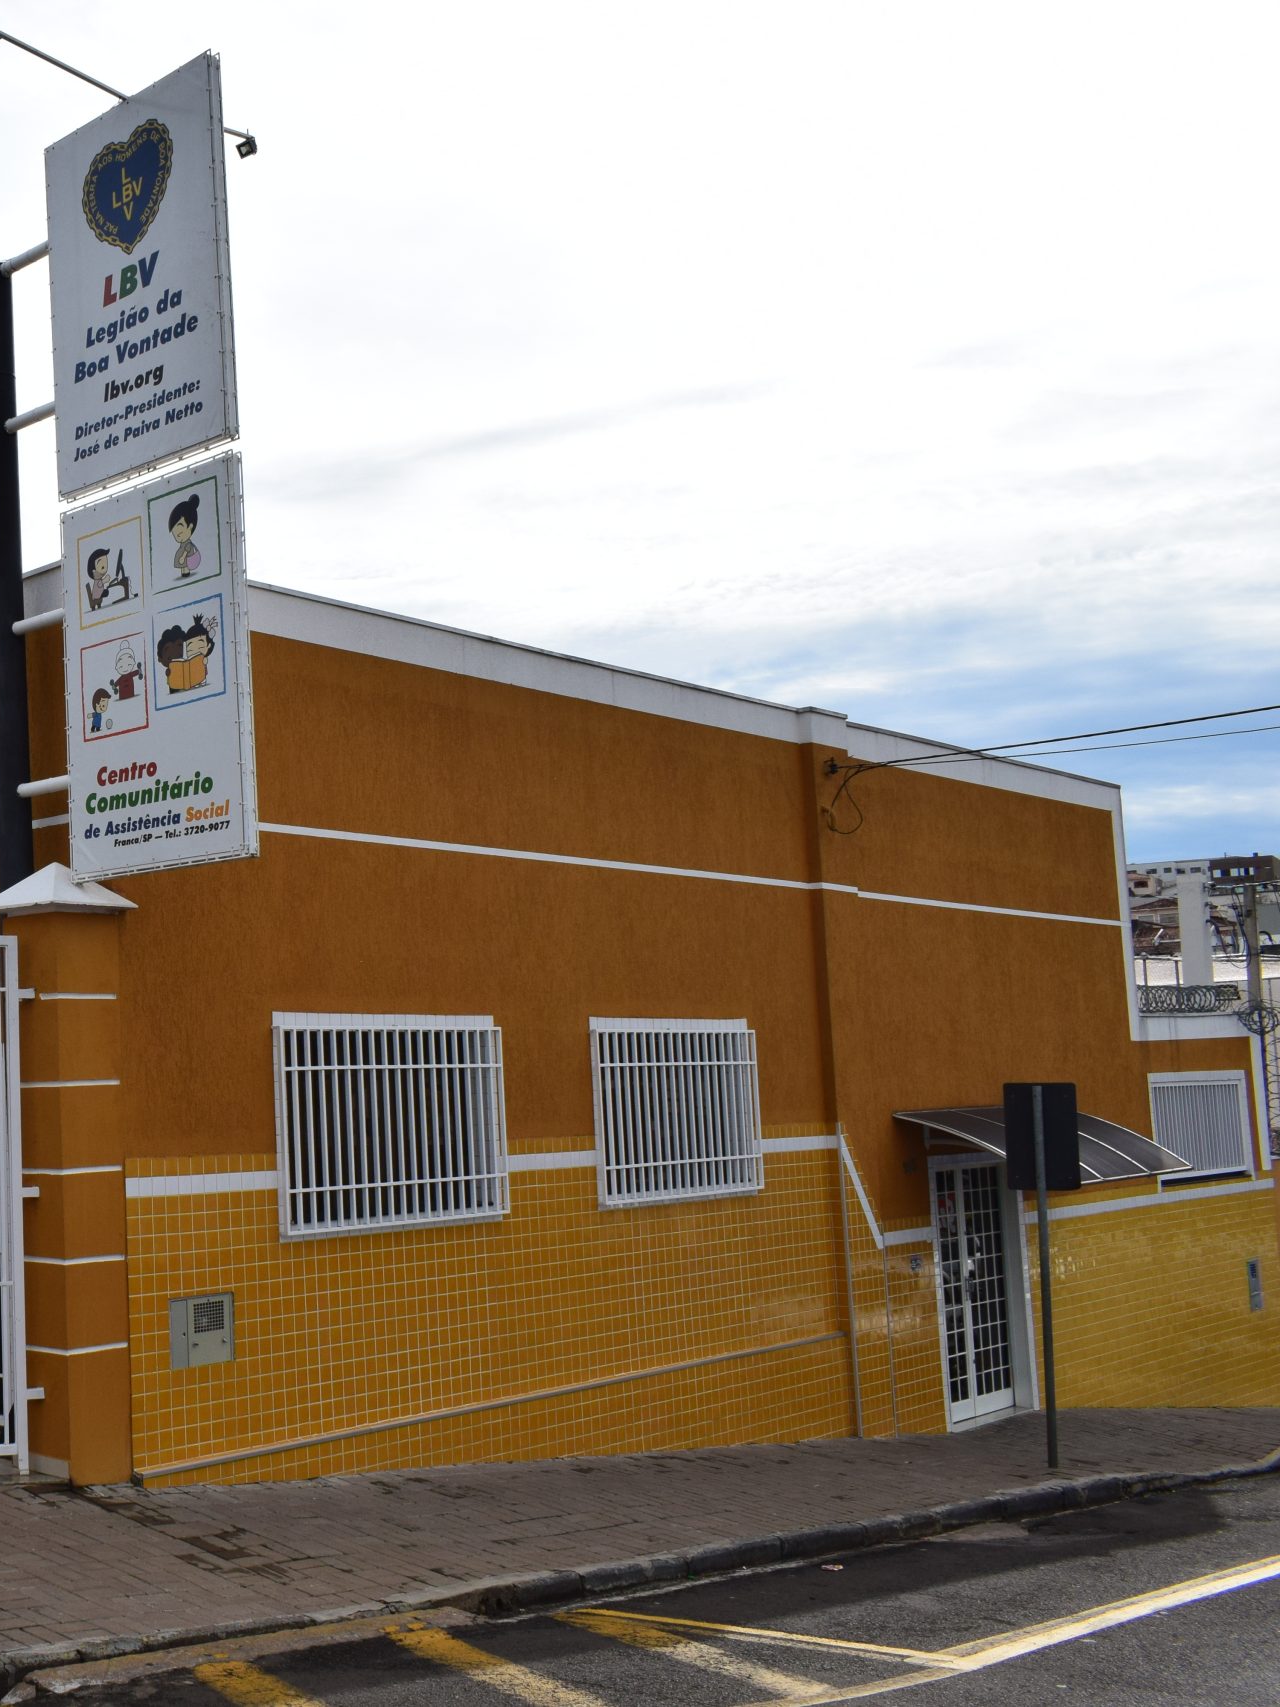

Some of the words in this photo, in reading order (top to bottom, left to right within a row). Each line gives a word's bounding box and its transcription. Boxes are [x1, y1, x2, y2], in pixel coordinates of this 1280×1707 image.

[88, 175, 99, 214] TERRA
[97, 153, 113, 171] AOS
[115, 131, 148, 163] HOMENS
[140, 170, 164, 223] VONTADE
[103, 250, 160, 308] LBV
[85, 305, 149, 348] Legião
[156, 289, 183, 315] da
[74, 354, 109, 384] Boa
[115, 312, 198, 364] Vontade
[74, 379, 201, 440] Diretor-Presidente:
[103, 364, 164, 403] lbv.org
[73, 438, 100, 462] José
[103, 432, 119, 450] de
[123, 417, 160, 443] Paiva
[164, 400, 204, 426] Netto
[85, 770, 214, 815] Comunitário
[96, 761, 158, 787] Centro
[84, 823, 101, 840] de
[104, 809, 181, 837] Assistência
[184, 799, 230, 823] Social
[113, 833, 153, 848] Franca/SP
[165, 829, 182, 840] Tel.:
[183, 820, 231, 836] 3720-9077
